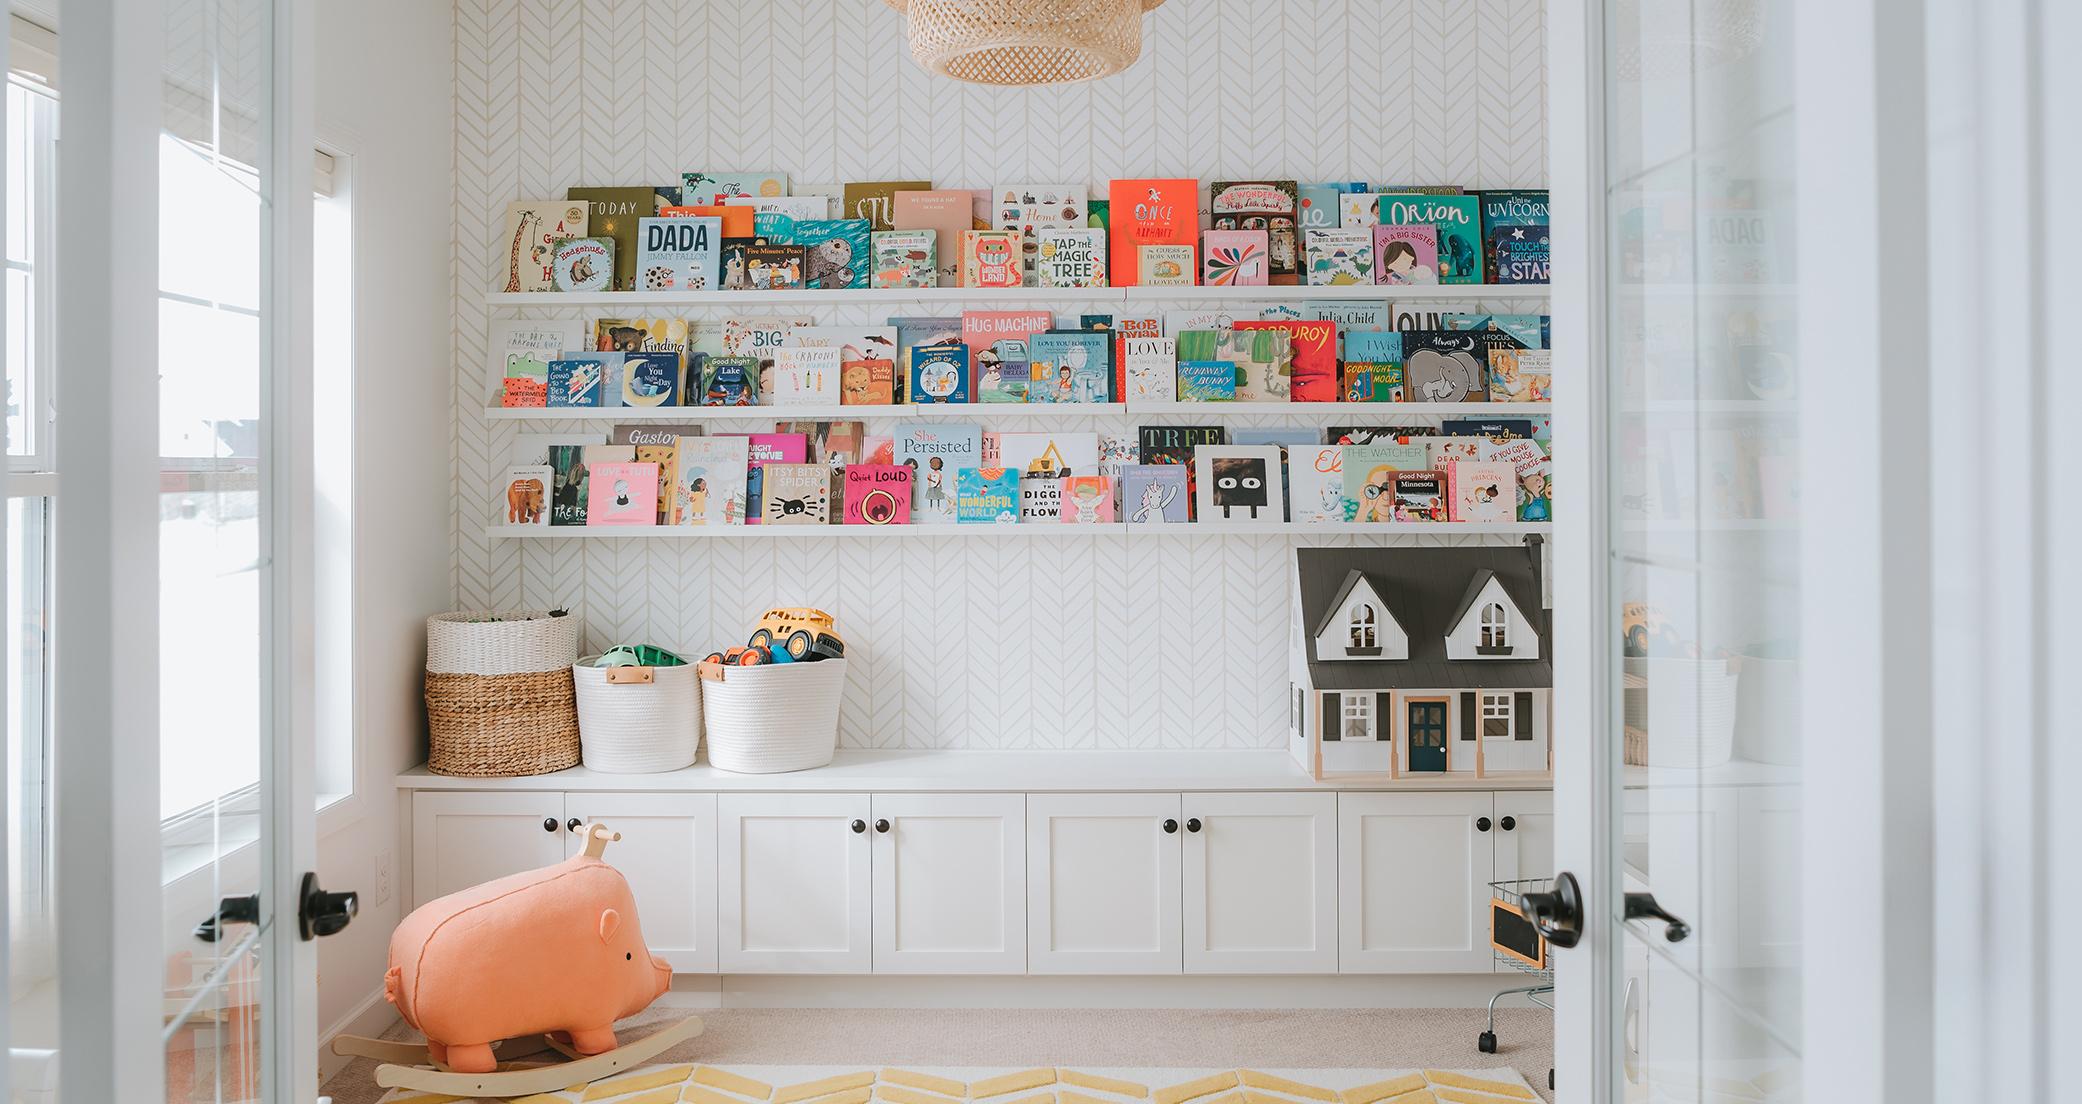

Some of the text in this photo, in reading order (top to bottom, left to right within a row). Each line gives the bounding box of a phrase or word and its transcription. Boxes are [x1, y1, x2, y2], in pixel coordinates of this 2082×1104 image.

[1236, 190, 1288, 203] WONDERFUL
[588, 202, 637, 216] TODAY
[856, 196, 896, 230] STU
[1135, 203, 1173, 221] ONCE
[1488, 201, 1550, 217] UNICORN
[556, 221, 565, 232] A
[648, 225, 708, 252] DADA
[1053, 239, 1076, 250] TAP
[1378, 237, 1390, 248] I'M
[1390, 233, 1397, 241] A
[1397, 231, 1410, 239] BIG
[1411, 232, 1436, 248] SISTER
[1509, 241, 1539, 251] TOUCH
[647, 253, 677, 261] JIMMY
[1053, 250, 1092, 263] MAGIC
[1510, 251, 1549, 261] BRIGHTES
[1053, 264, 1092, 278] TREE
[1511, 262, 1550, 280] STAR
[1279, 305, 1301, 318] Places
[965, 316, 1049, 333] HUG MACHINE
[1347, 312, 1376, 325] Child
[752, 331, 783, 347] BIG
[1432, 336, 1460, 347] Always
[643, 337, 685, 356] Finding
[1127, 342, 1174, 356] LOVE
[1484, 342, 1516, 351] TIES
[731, 356, 752, 366] Night
[1383, 353, 1403, 362] Mo
[918, 357, 941, 371] WIZARD
[1346, 365, 1396, 373] GOODNIGHT
[649, 368, 663, 376] You
[658, 379, 671, 387] Day
[1374, 374, 1403, 384] MOON
[628, 429, 680, 446] Gaston
[915, 430, 938, 441] She
[1144, 429, 1219, 447] TREE
[749, 445, 772, 453] NIGHT
[904, 438, 972, 454] Persisted
[1498, 448, 1511, 459] YOU
[1512, 441, 1529, 454] GIVE
[749, 452, 786, 461] RYONE
[1347, 447, 1423, 459] THE WATCHER
[1510, 450, 1535, 464] MOUSE
[1514, 457, 1540, 474] COOKIE
[770, 467, 828, 478] ITSY BITSY
[875, 471, 908, 482] LOUD
[1398, 472, 1436, 481] Good Night
[779, 478, 819, 488] SPIDER
[1024, 490, 1062, 499] DIGG
[960, 496, 1013, 508] WONDERFUL
[1022, 508, 1062, 517] FLOW
